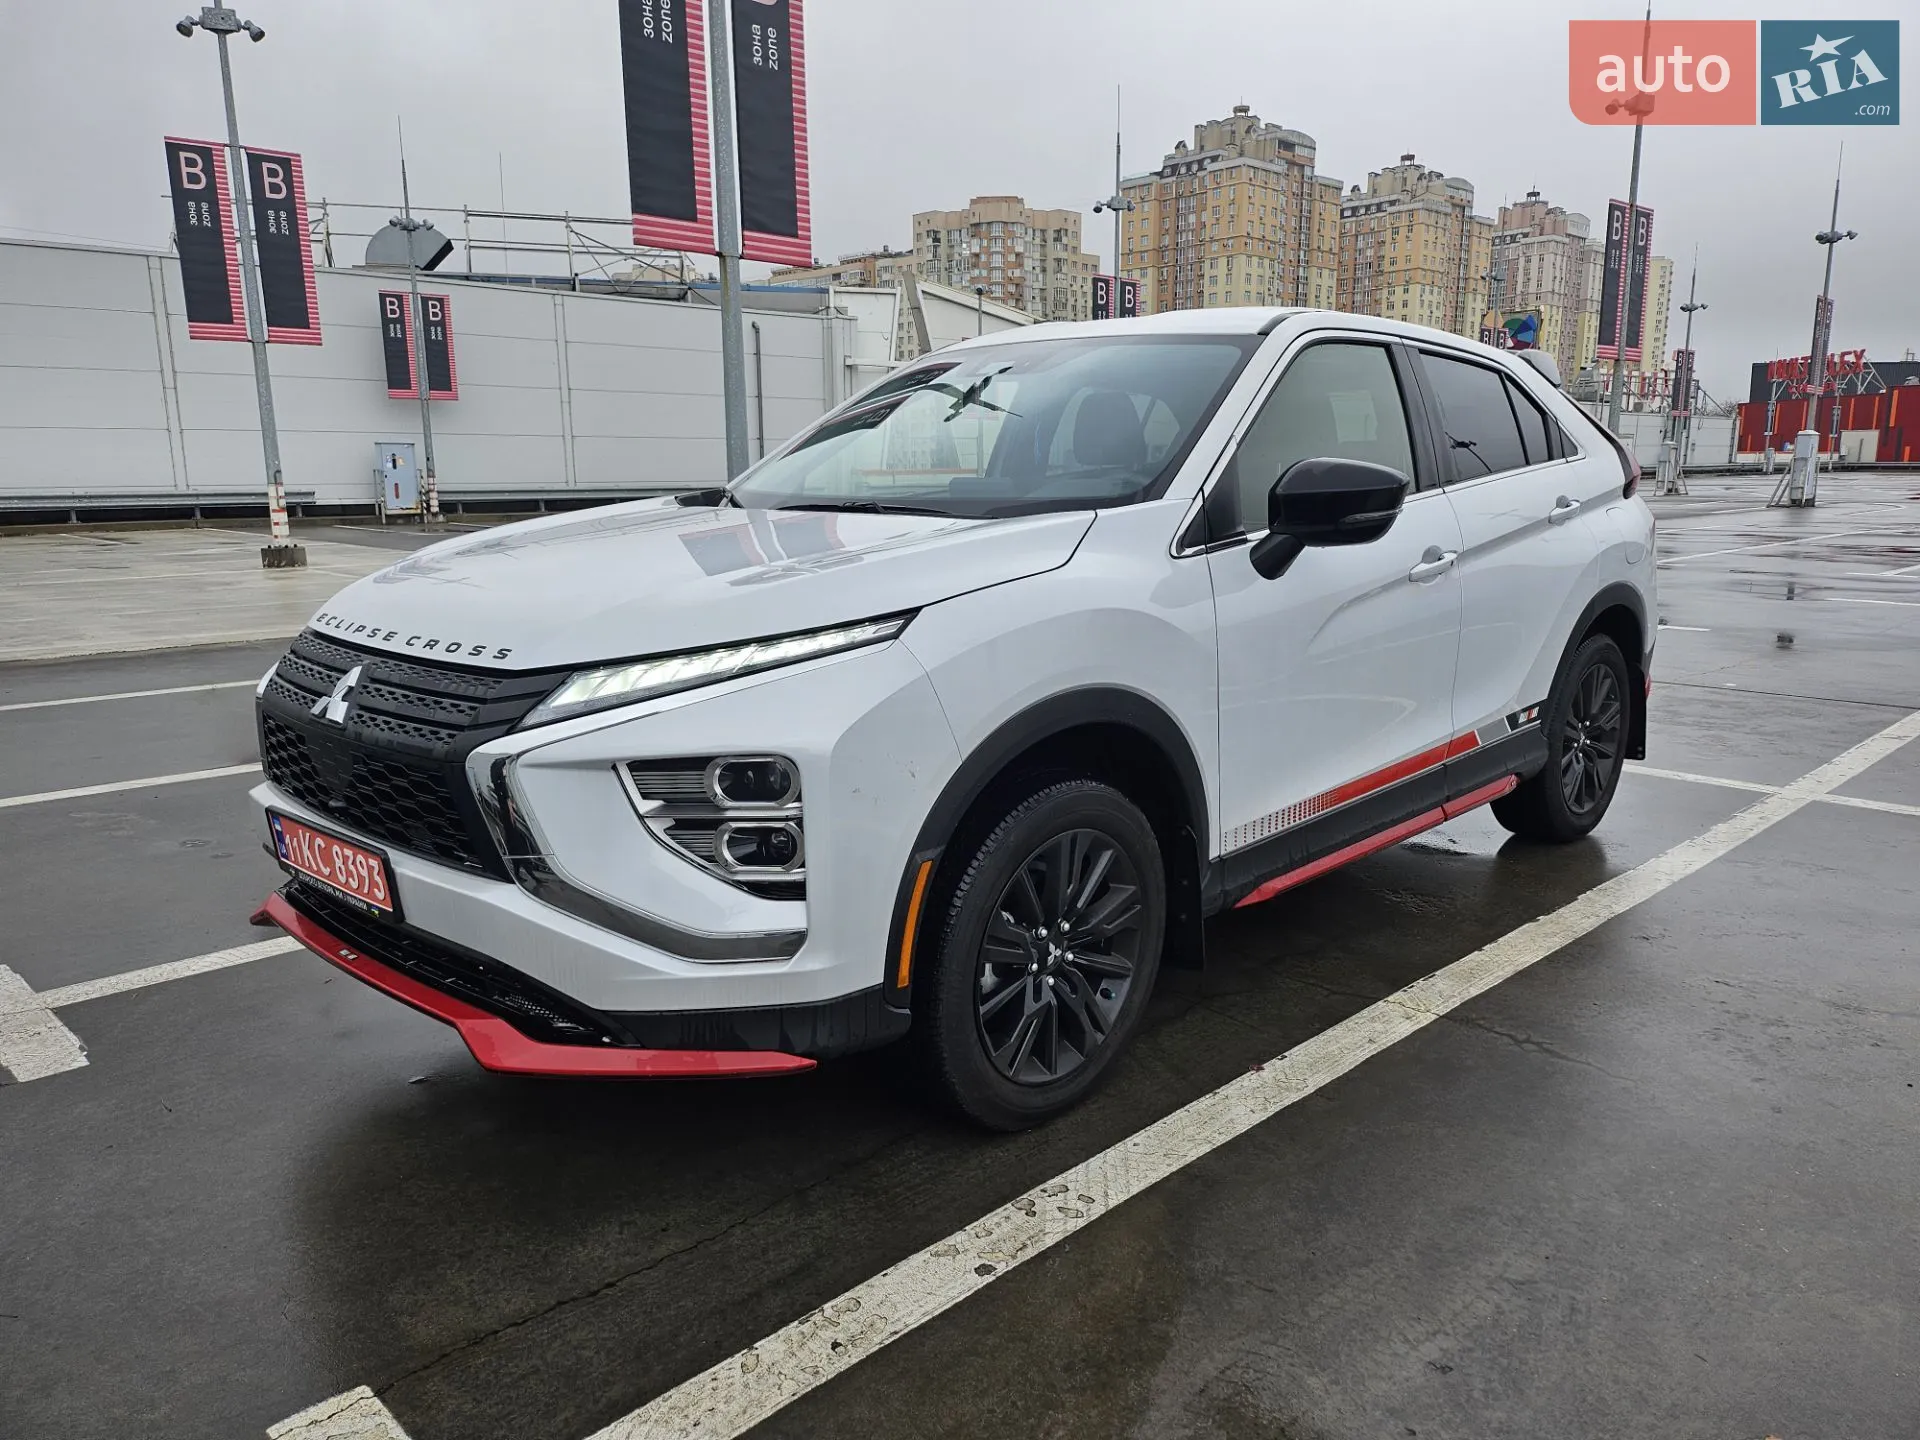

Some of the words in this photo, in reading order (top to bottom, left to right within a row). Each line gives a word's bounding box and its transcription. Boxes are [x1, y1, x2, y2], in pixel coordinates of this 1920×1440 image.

[660, 0, 673, 44] zone
[752, 24, 762, 66] зона
[767, 27, 778, 71] zone
[179, 151, 207, 190] B
[262, 161, 287, 200] B
[188, 201, 198, 226] зона
[201, 202, 212, 227] zone
[267, 210, 277, 234] зона
[280, 210, 289, 235] zone
[1612, 210, 1622, 240] B
[1638, 216, 1647, 246] B
[385, 297, 400, 318] B
[1097, 282, 1107, 304] B
[1125, 286, 1134, 308] B
[428, 300, 442, 321] B
[316, 613, 398, 642] ECLIPSE
[405, 635, 512, 660] CROSS
[332, 845, 385, 900] 8393
